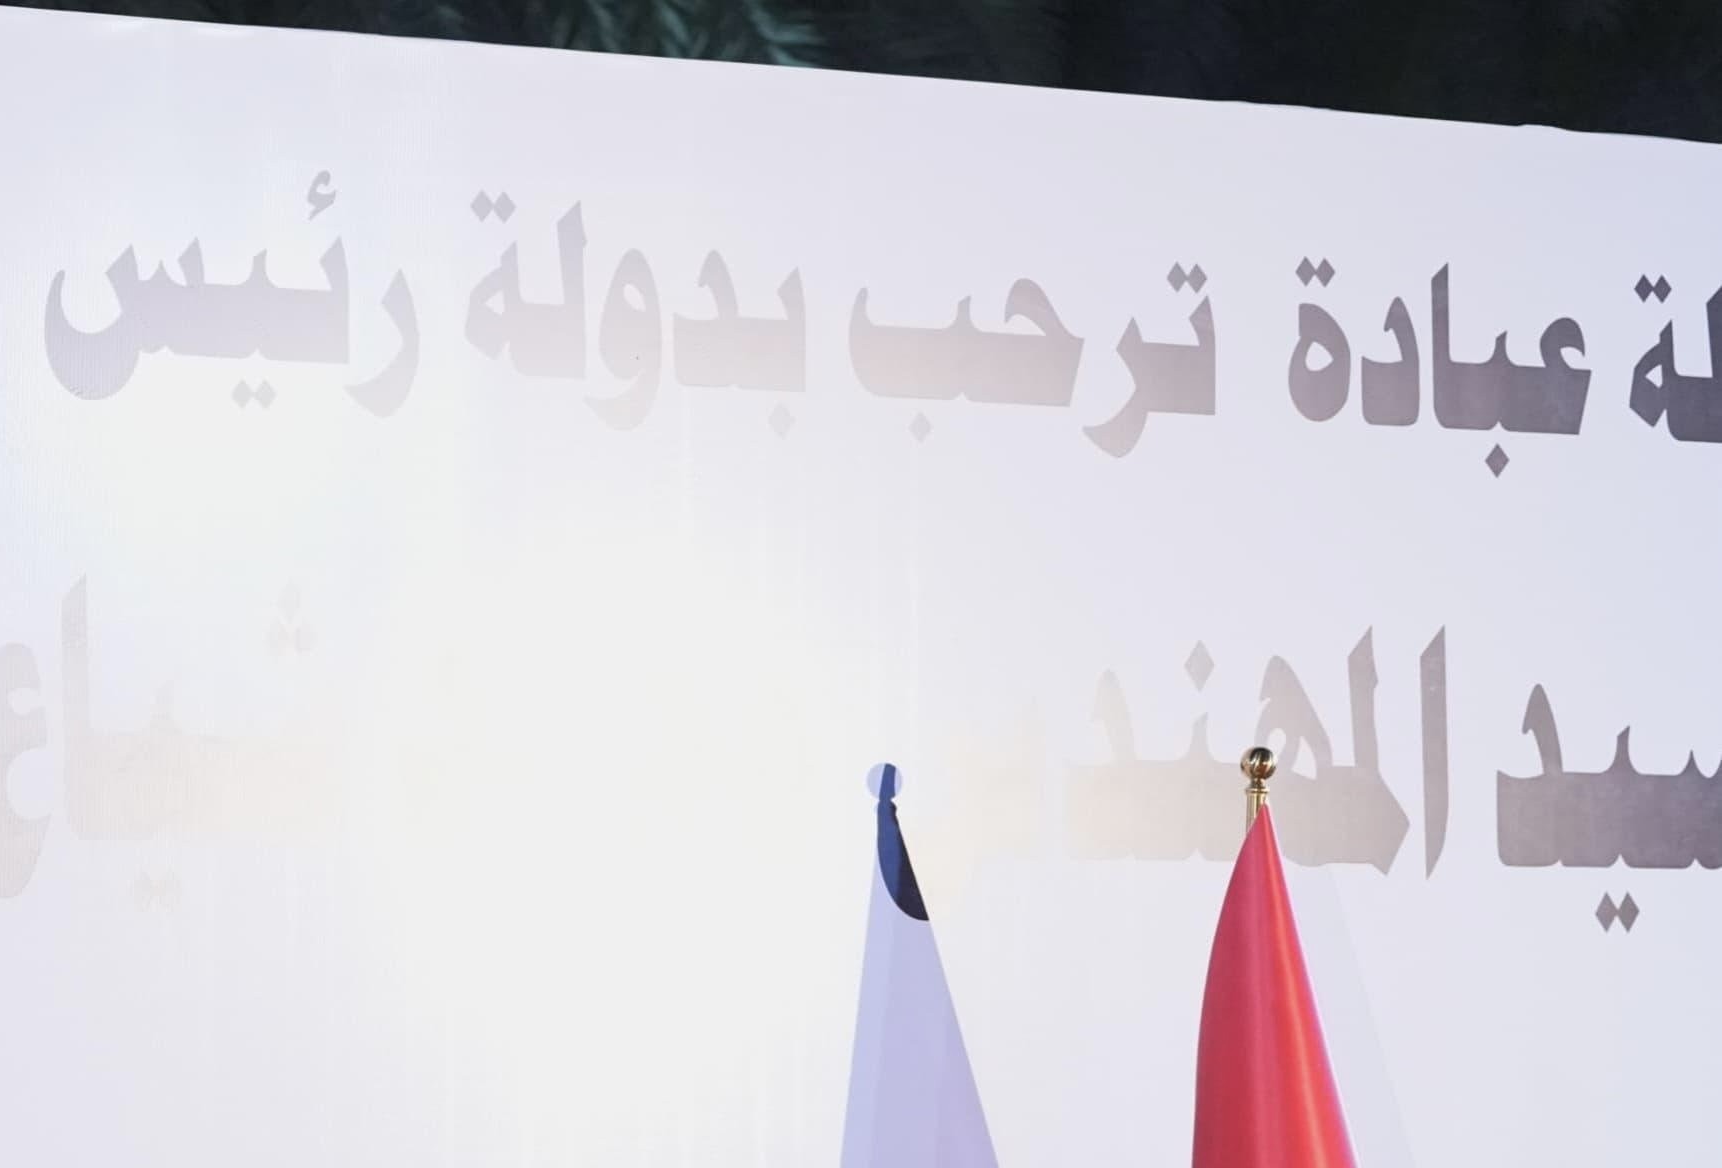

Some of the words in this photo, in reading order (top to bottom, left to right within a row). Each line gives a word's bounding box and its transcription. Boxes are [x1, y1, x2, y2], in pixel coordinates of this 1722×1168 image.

[44, 169, 419, 418] رئيس
[465, 189, 806, 438] بدولة
[849, 261, 1216, 458] ترحب
[1288, 255, 1591, 478] عبادة
